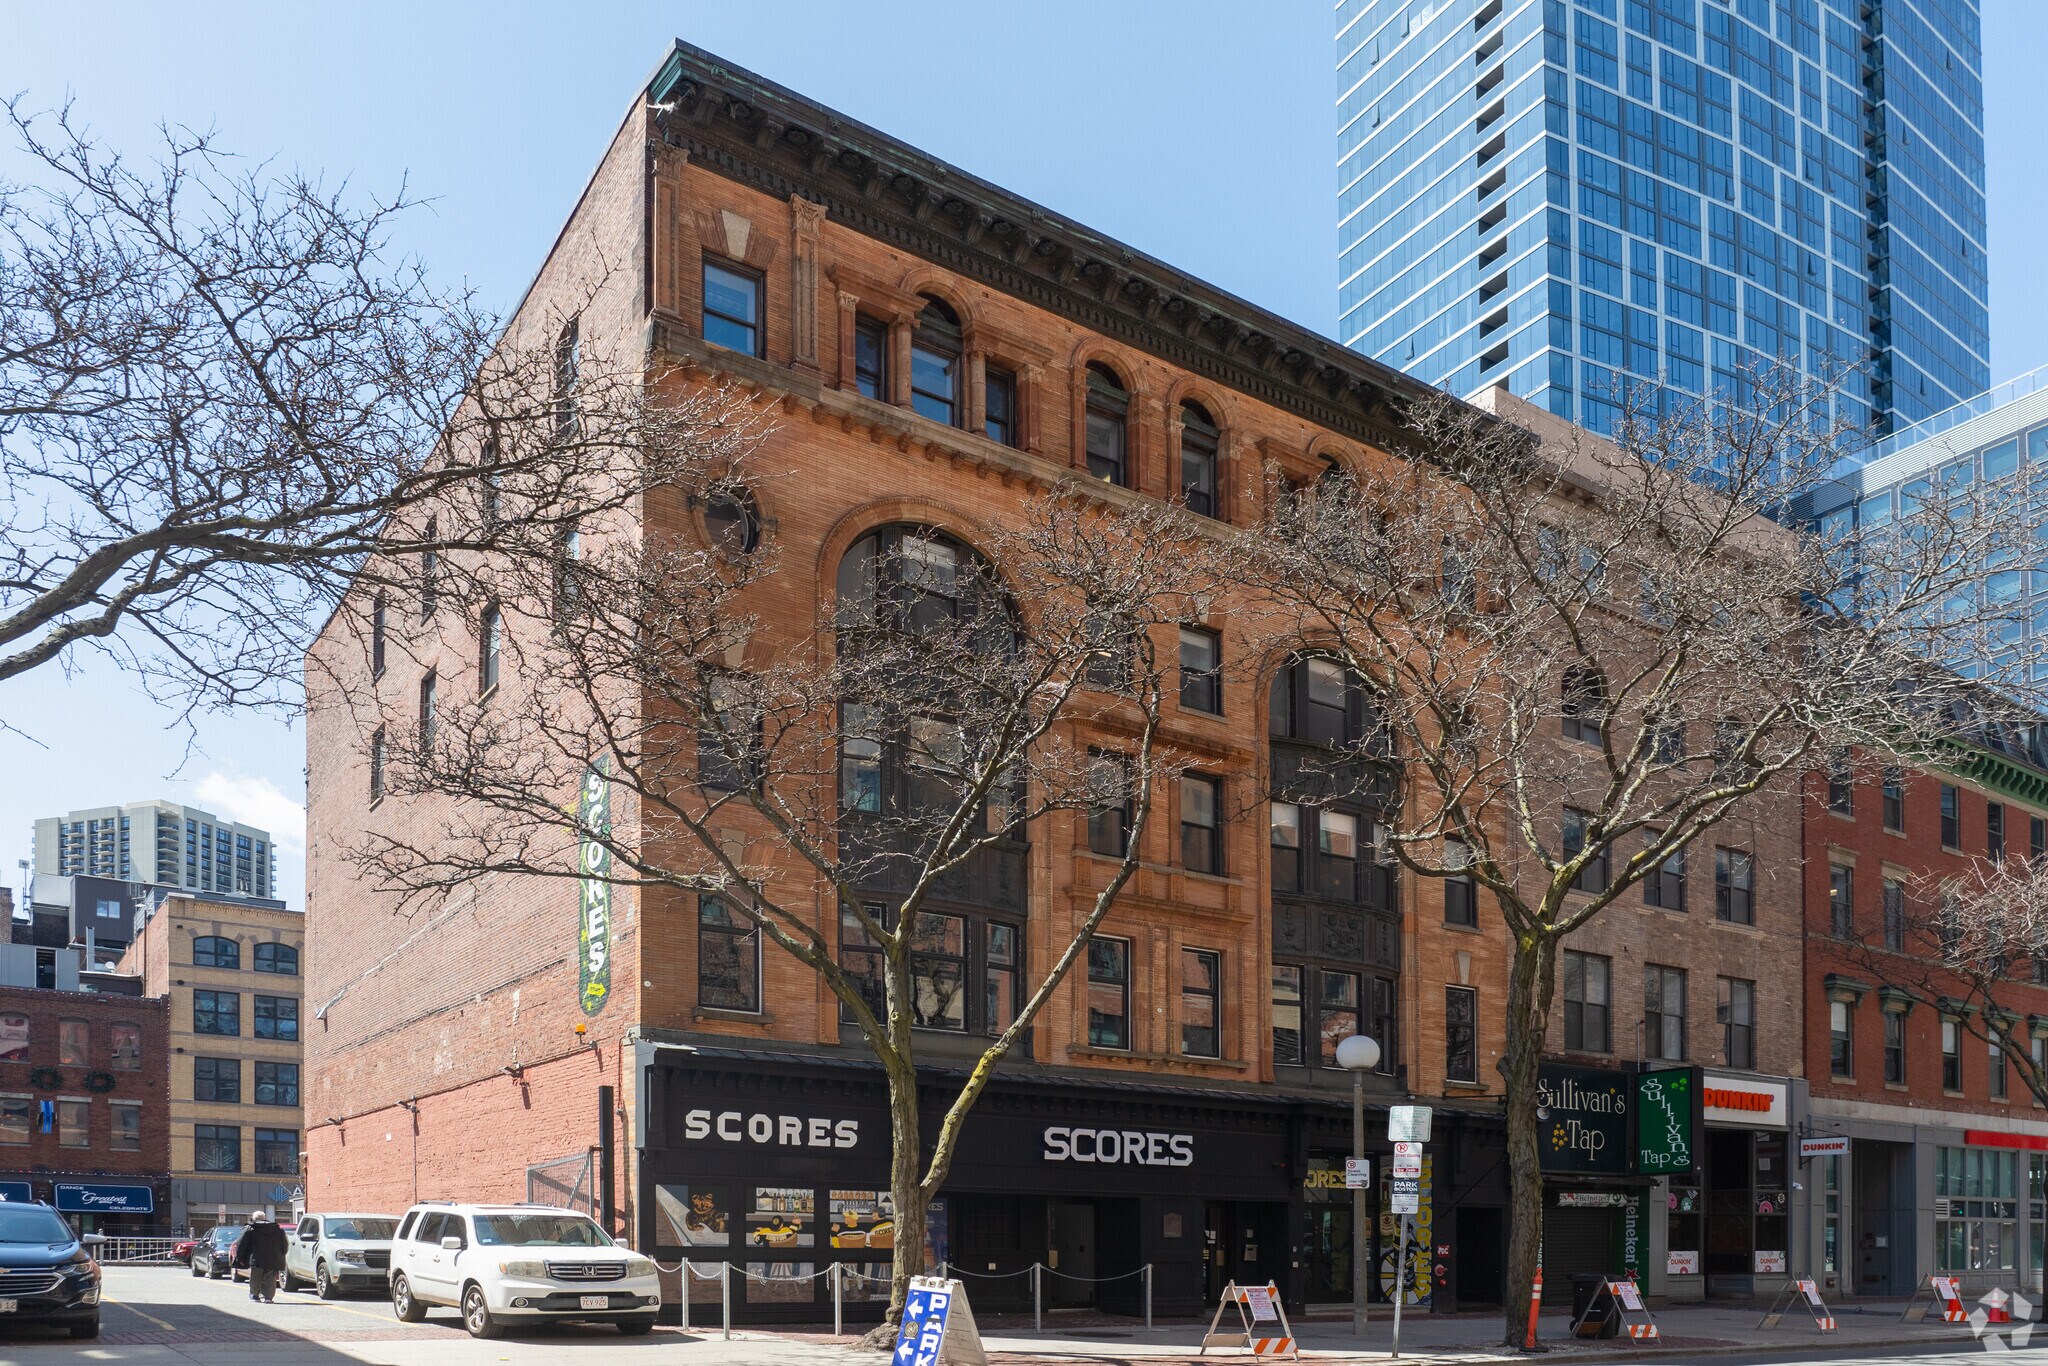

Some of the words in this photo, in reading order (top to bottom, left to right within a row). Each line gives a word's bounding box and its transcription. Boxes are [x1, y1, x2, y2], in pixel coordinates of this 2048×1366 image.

[587, 773, 605, 973] SCORES
[1703, 1087, 1775, 1112] DUNKIN'
[685, 1109, 859, 1148] SCORES
[1567, 1119, 1605, 1161] Tap
[1640, 1078, 1690, 1166] Sullivan's
[1044, 1126, 1193, 1167] SCORES
[1641, 1150, 1671, 1168] Tap
[1803, 1142, 1845, 1151] DUNKIN'
[82, 1192, 127, 1204] Greatest
[1625, 1195, 1639, 1263] Heineken
[914, 1293, 947, 1366] PARK
